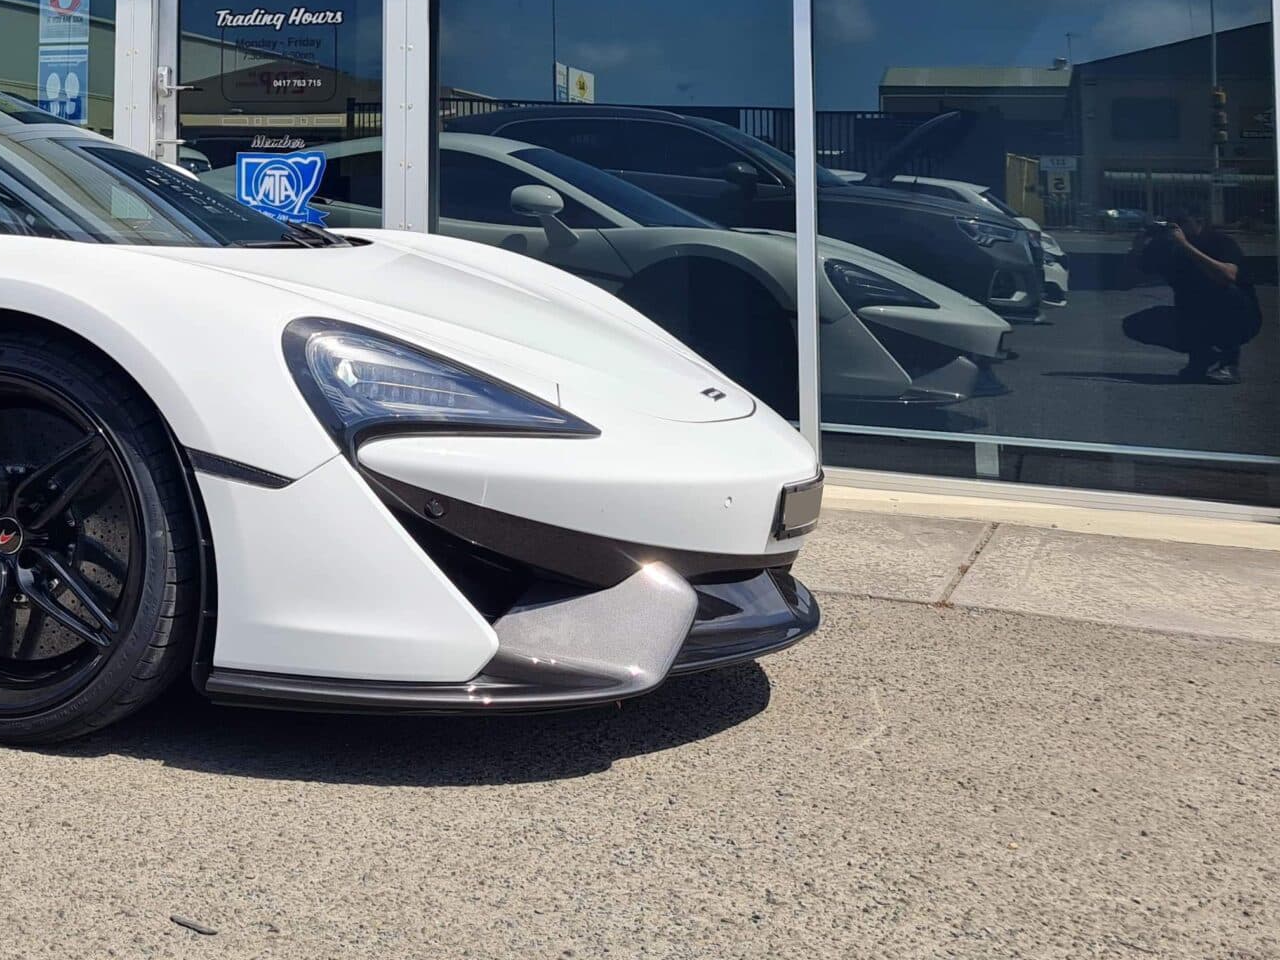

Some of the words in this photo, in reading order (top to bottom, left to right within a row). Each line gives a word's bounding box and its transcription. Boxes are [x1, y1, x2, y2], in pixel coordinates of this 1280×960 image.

[216, 8, 286, 30] Trading
[288, 7, 343, 25] Hours
[273, 79, 291, 88] 0417
[251, 134, 306, 148] Member
[256, 169, 298, 206] MTA
